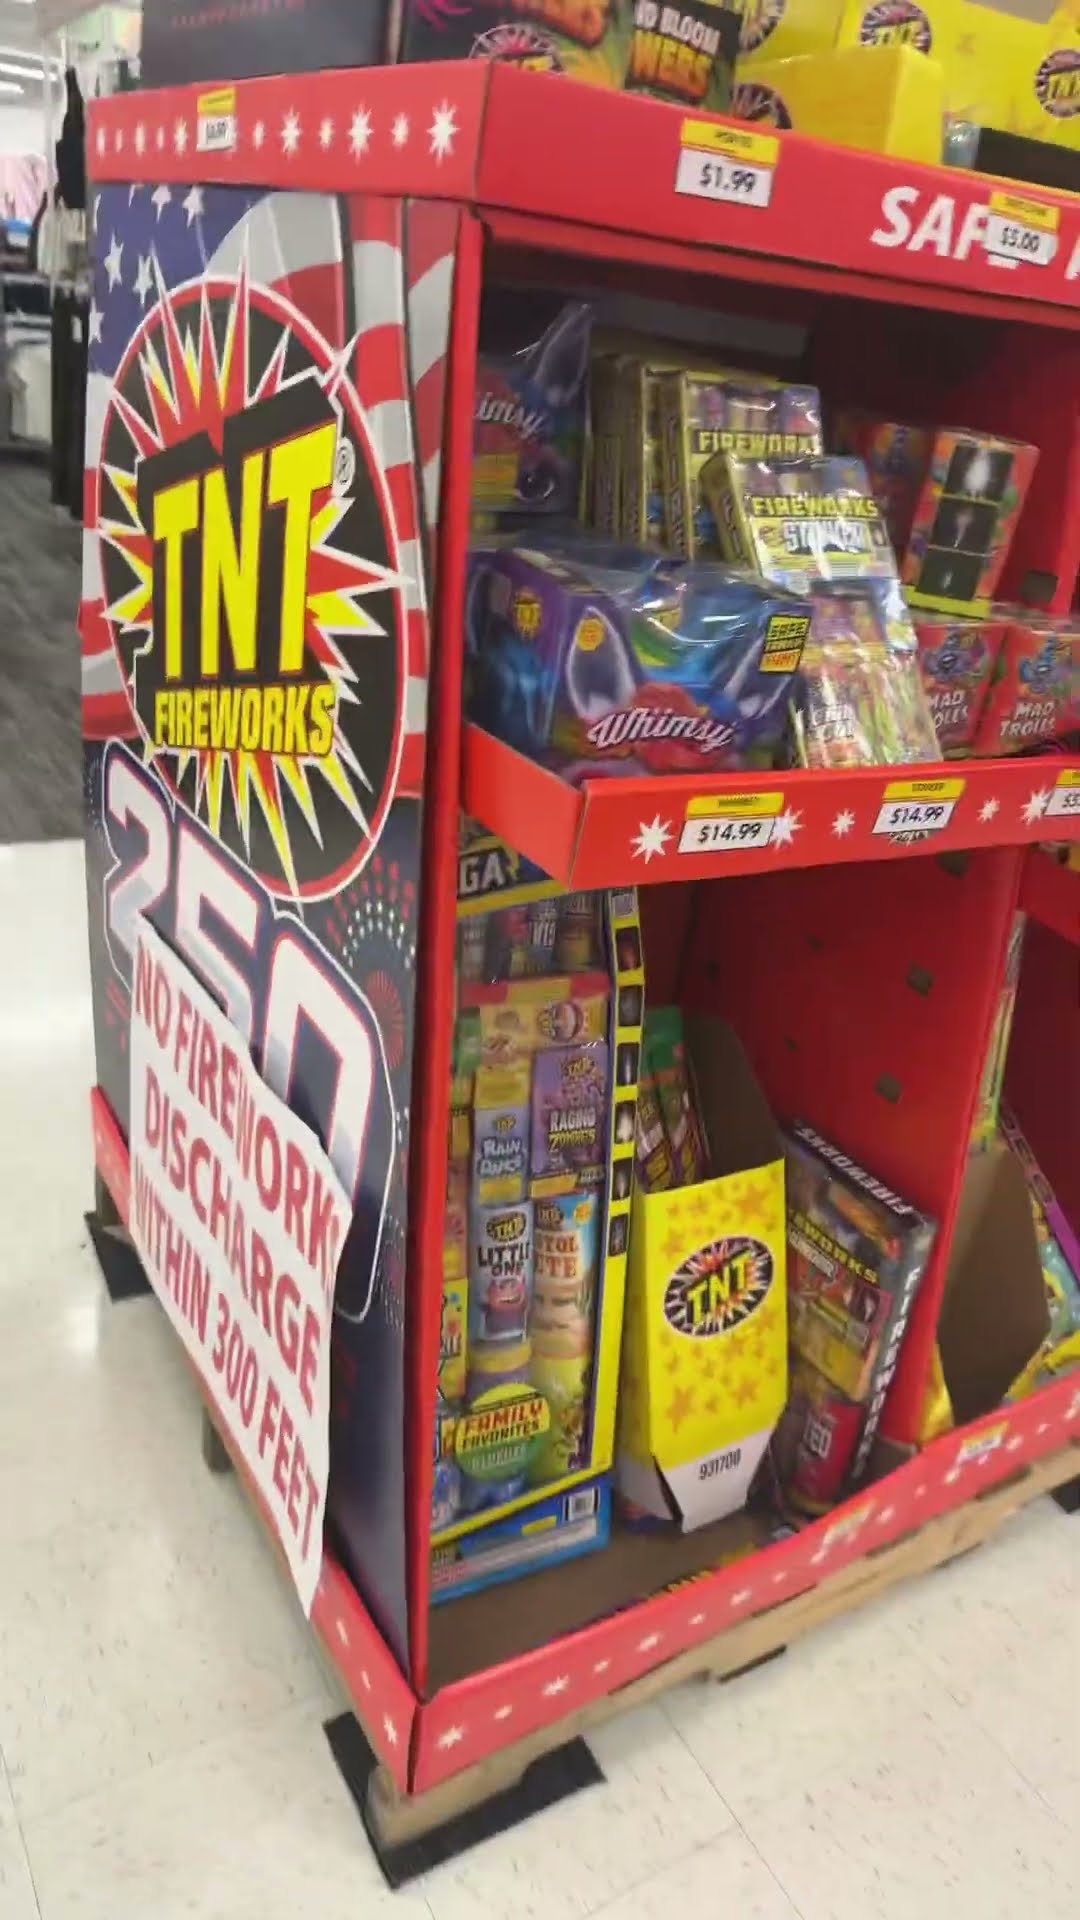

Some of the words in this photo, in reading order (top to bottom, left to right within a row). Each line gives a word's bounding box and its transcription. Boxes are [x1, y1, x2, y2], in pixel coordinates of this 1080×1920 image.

[700, 163, 755, 193] $1.99
[870, 185, 1022, 269] SAF
[1001, 226, 1040, 253] $5.00
[752, 496, 879, 517] FIREWORKS
[152, 421, 338, 683] TNT
[153, 682, 336, 756] FIREWORKS
[1014, 701, 1056, 721] MAD
[587, 706, 736, 753] Whimsy
[697, 822, 762, 843] $14.99
[889, 805, 944, 824] $14.99
[459, 851, 506, 897] GA
[136, 935, 172, 1050] NO
[550, 1107, 597, 1132] RAGING
[145, 1064, 321, 1419] DISCHARGE
[687, 1251, 752, 1327] TNT
[134, 1150, 211, 1346] WITHIN
[211, 1292, 259, 1429] 300
[257, 1375, 320, 1562] FEET
[462, 1418, 540, 1450] FAVORITES
[463, 1400, 545, 1436] FAMILY
[699, 1447, 742, 1481] 931700
